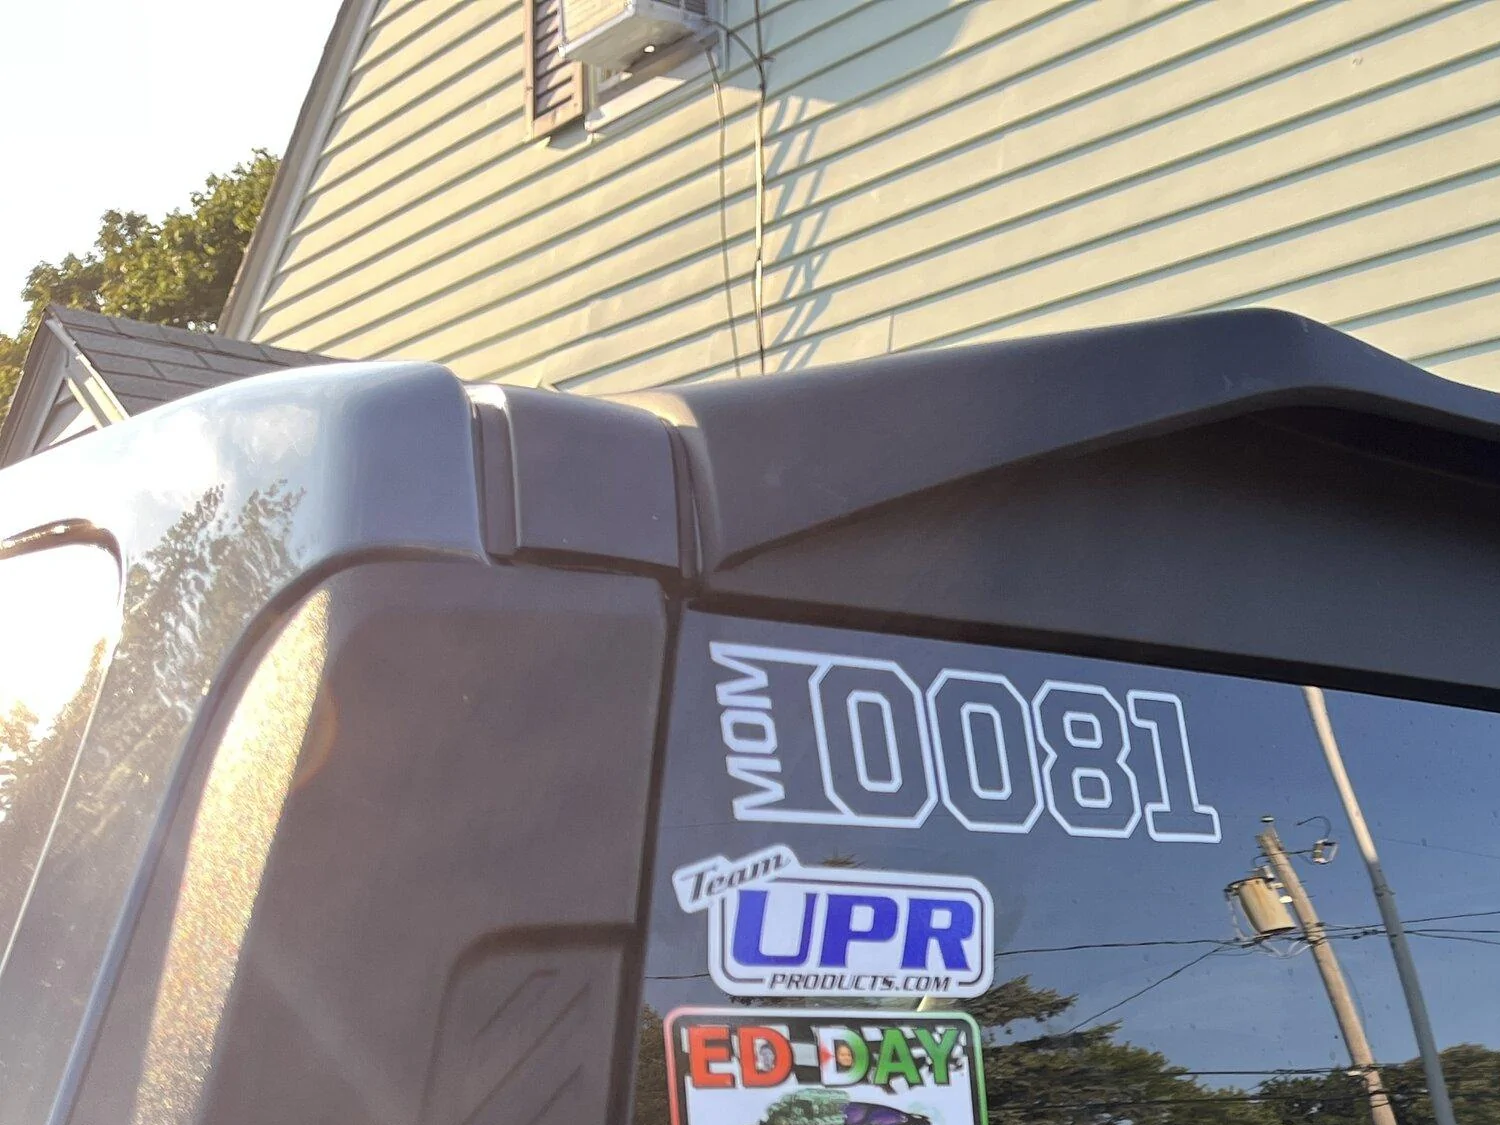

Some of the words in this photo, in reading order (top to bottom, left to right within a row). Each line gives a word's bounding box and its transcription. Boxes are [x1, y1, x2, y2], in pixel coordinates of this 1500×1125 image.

[710, 641, 786, 823] MOM
[807, 658, 1222, 843] 0081
[680, 853, 792, 904] Team
[731, 889, 975, 971] UPR
[768, 972, 951, 992] PRODUCTS.COM
[686, 1025, 794, 1089] ED
[818, 1025, 959, 1087] DAY
